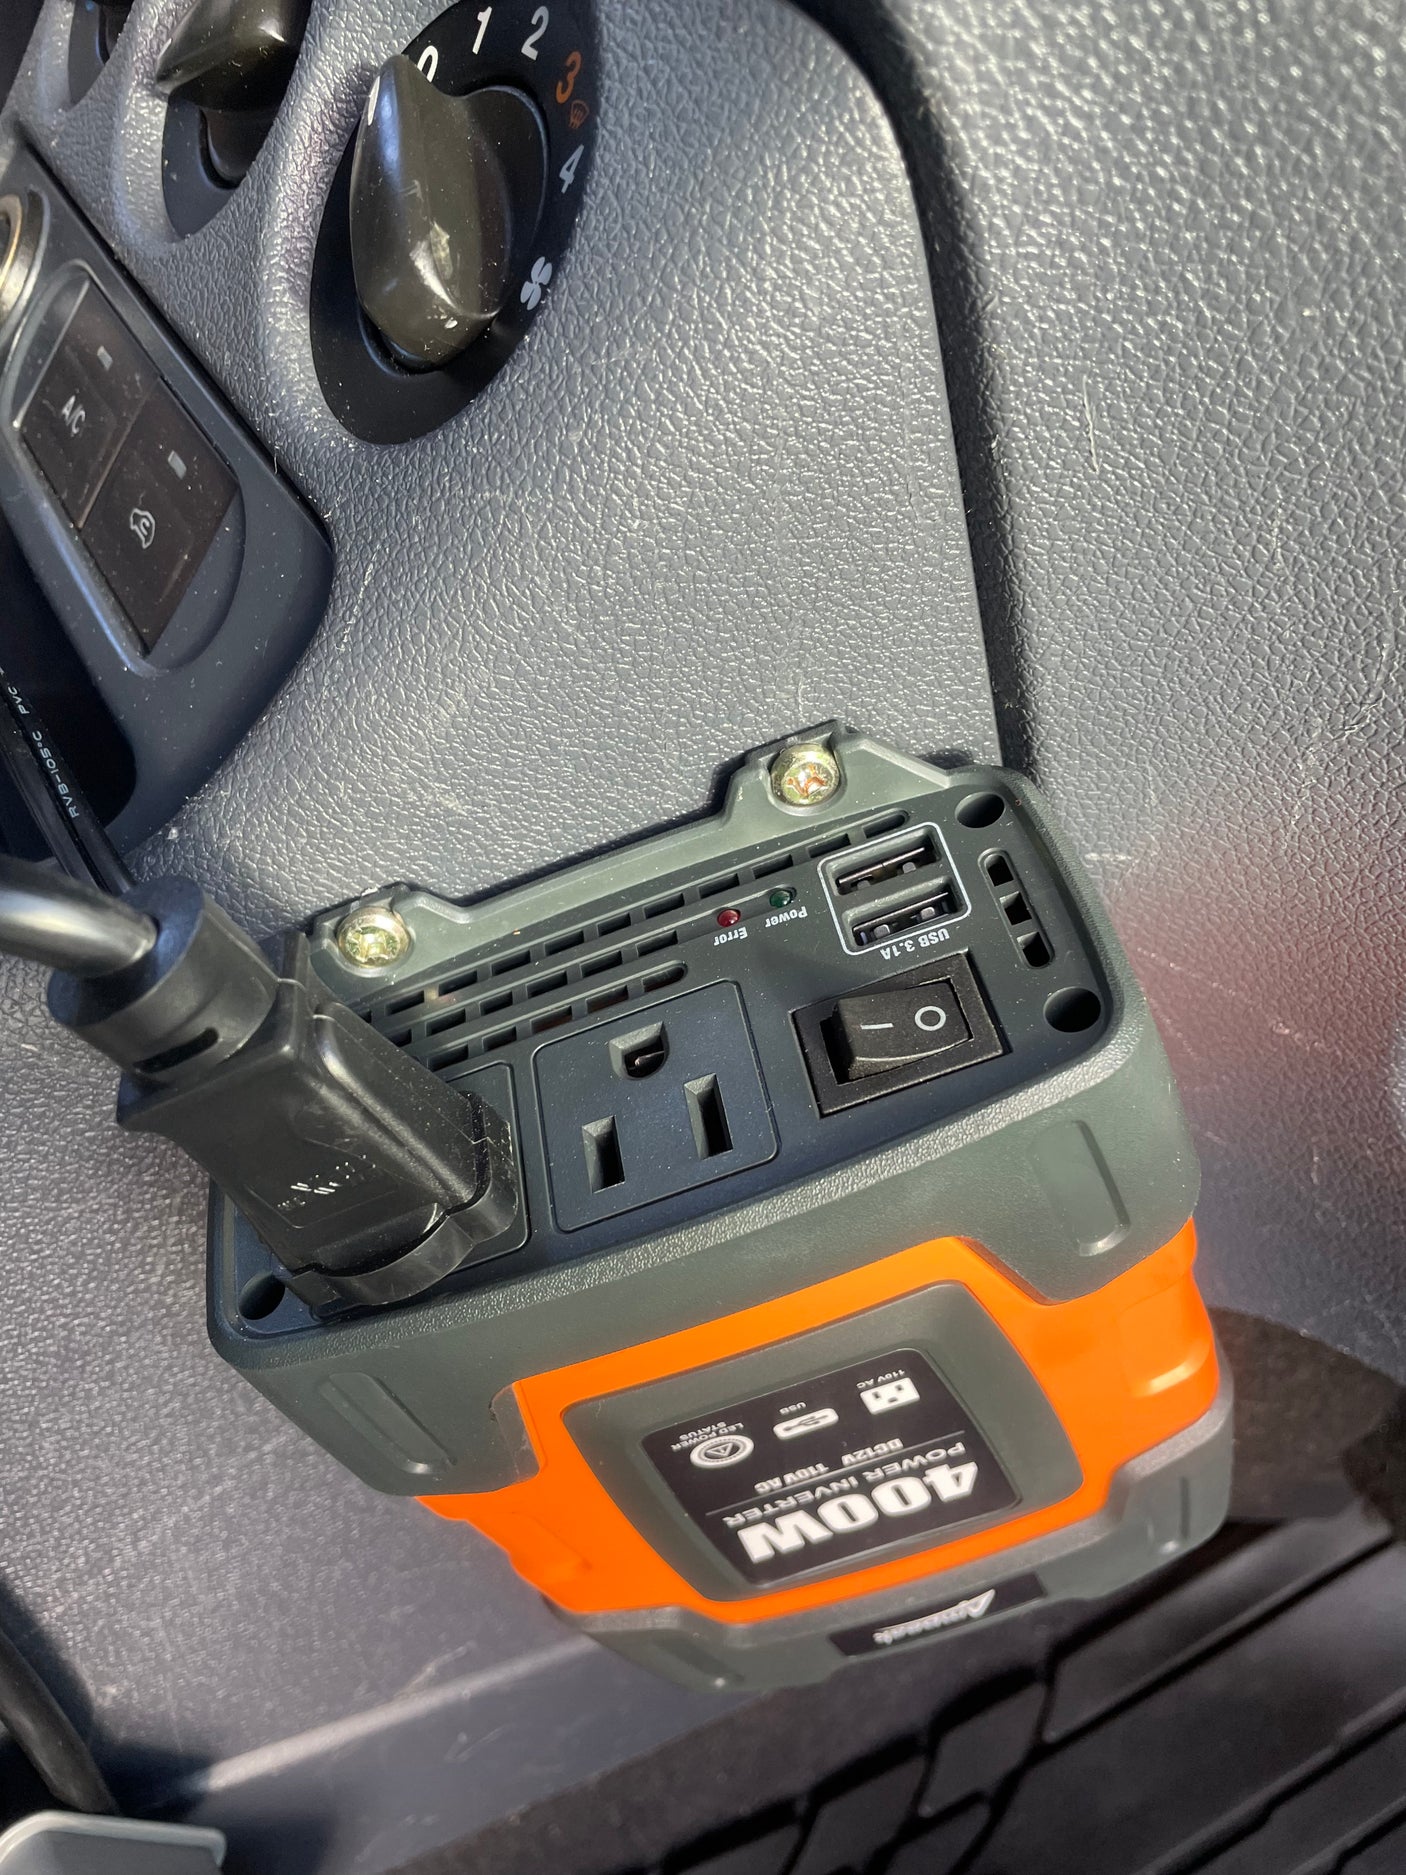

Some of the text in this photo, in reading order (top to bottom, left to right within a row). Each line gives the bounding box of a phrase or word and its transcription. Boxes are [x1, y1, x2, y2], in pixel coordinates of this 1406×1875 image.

[472, 6, 493, 55] 1
[521, 5, 549, 61] 2
[556, 51, 582, 104] 3
[559, 144, 585, 194] 4
[61, 394, 86, 435] A/C
[7, 686, 30, 715] PVC
[765, 905, 808, 929] Power
[713, 926, 748, 947] Error
[879, 928, 950, 961] USB 3.1A
[856, 1369, 905, 1390] 110V AC
[779, 1402, 807, 1415] USB
[670, 1422, 744, 1452] LED POWER
[679, 1421, 727, 1441] STATUS
[723, 1442, 966, 1528] POWER INVERTER
[754, 1438, 904, 1495] DC12V 110V AC
[737, 1462, 979, 1564] 400W
